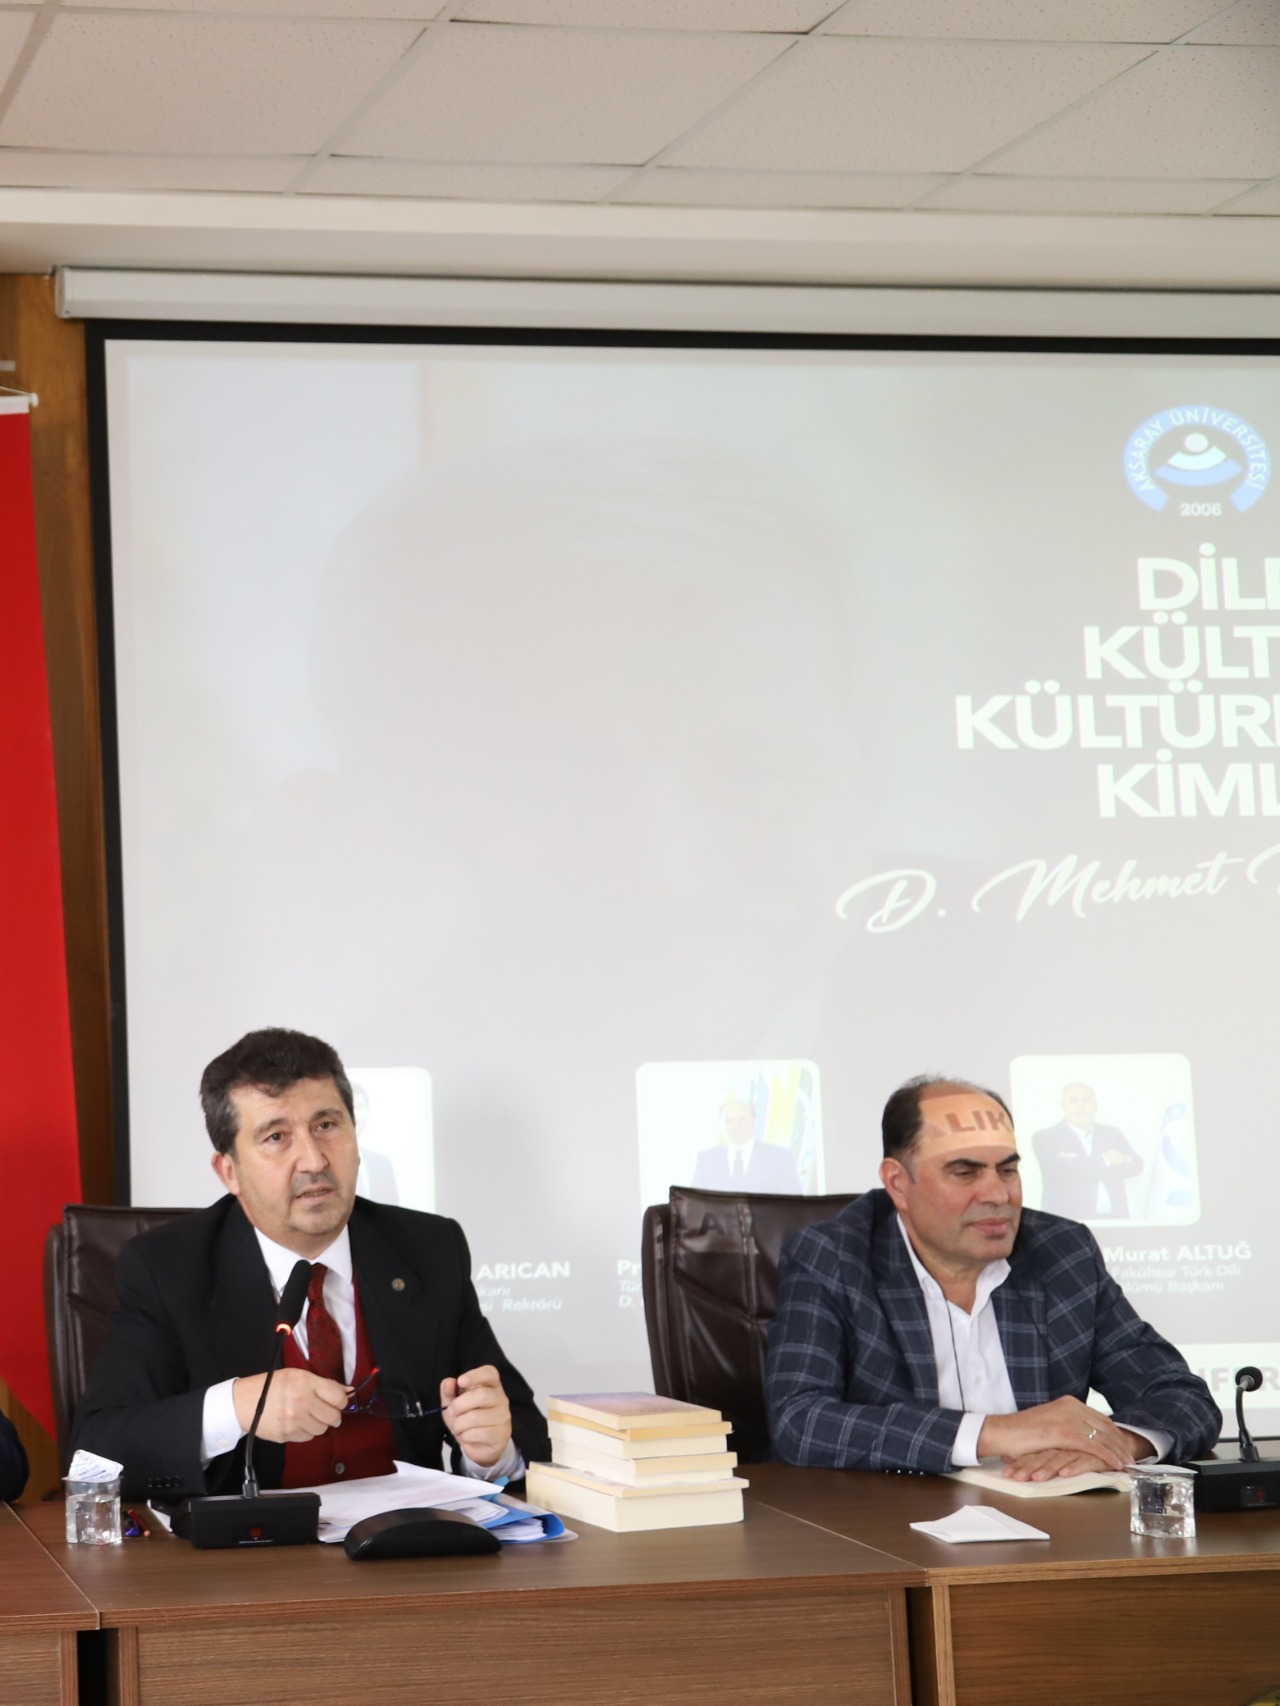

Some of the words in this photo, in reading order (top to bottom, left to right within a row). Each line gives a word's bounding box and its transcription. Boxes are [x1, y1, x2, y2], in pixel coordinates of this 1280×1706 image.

[1128, 419, 1165, 492] AKSARAY
[1180, 502, 1223, 517] 2006
[971, 850, 1245, 922] Mehmet
[1103, 1246, 1170, 1263] Murat
[1177, 1239, 1253, 1261] ALTUĞ
[476, 1261, 571, 1280] ARICAN
